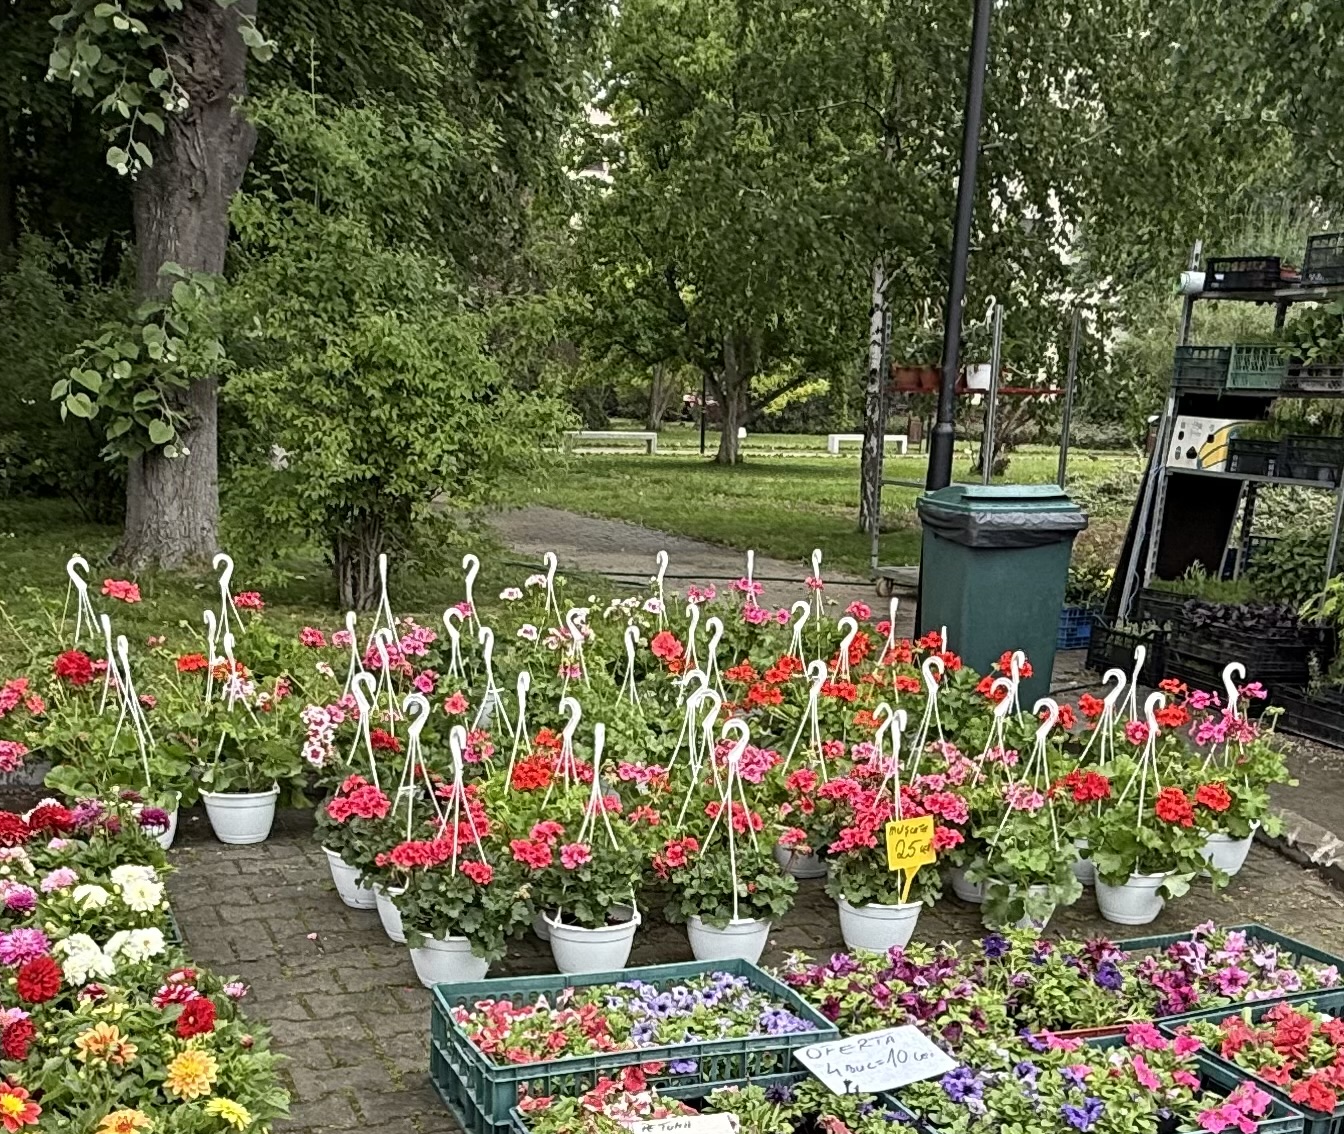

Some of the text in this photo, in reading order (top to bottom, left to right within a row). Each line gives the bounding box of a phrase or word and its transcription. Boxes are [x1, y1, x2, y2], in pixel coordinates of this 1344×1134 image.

[895, 839, 922, 859] 25
[806, 1031, 896, 1060] OFERTA
[826, 1063, 842, 1077] 4
